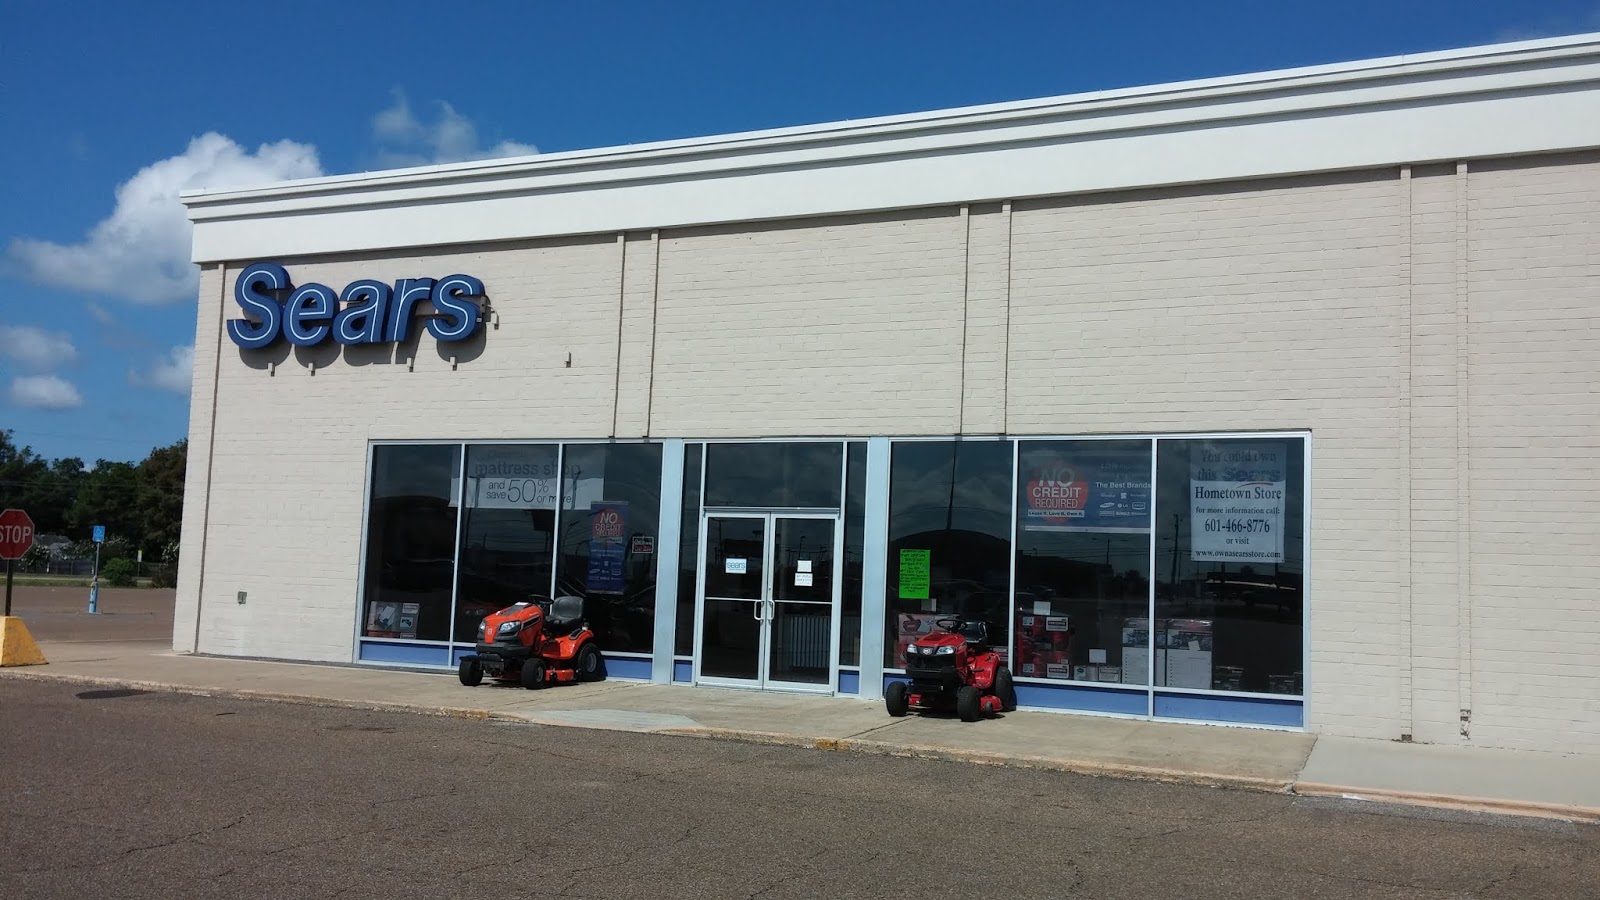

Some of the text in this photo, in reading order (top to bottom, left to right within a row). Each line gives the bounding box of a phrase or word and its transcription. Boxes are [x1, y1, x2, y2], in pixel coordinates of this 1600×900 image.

[227, 262, 485, 348] Sears
[475, 461, 538, 475] mattress
[1038, 467, 1076, 488] NO
[1198, 468, 1217, 481] this
[488, 480, 506, 490] and
[1095, 481, 1152, 489] The Best Brands
[486, 491, 506, 500] save
[1032, 487, 1082, 498] CREDIT
[1195, 486, 1281, 500] Hometown Store
[537, 495, 572, 503] or mre
[1035, 498, 1079, 509] REQUIRED
[1195, 506, 1205, 514] for
[1225, 506, 1264, 514] information
[600, 512, 618, 524] NO
[1205, 518, 1270, 532] 601-466-8776
[0, 525, 31, 543] STOP
[1235, 536, 1250, 544] visit
[1195, 550, 1280, 558] www.ownasearsstore.com
